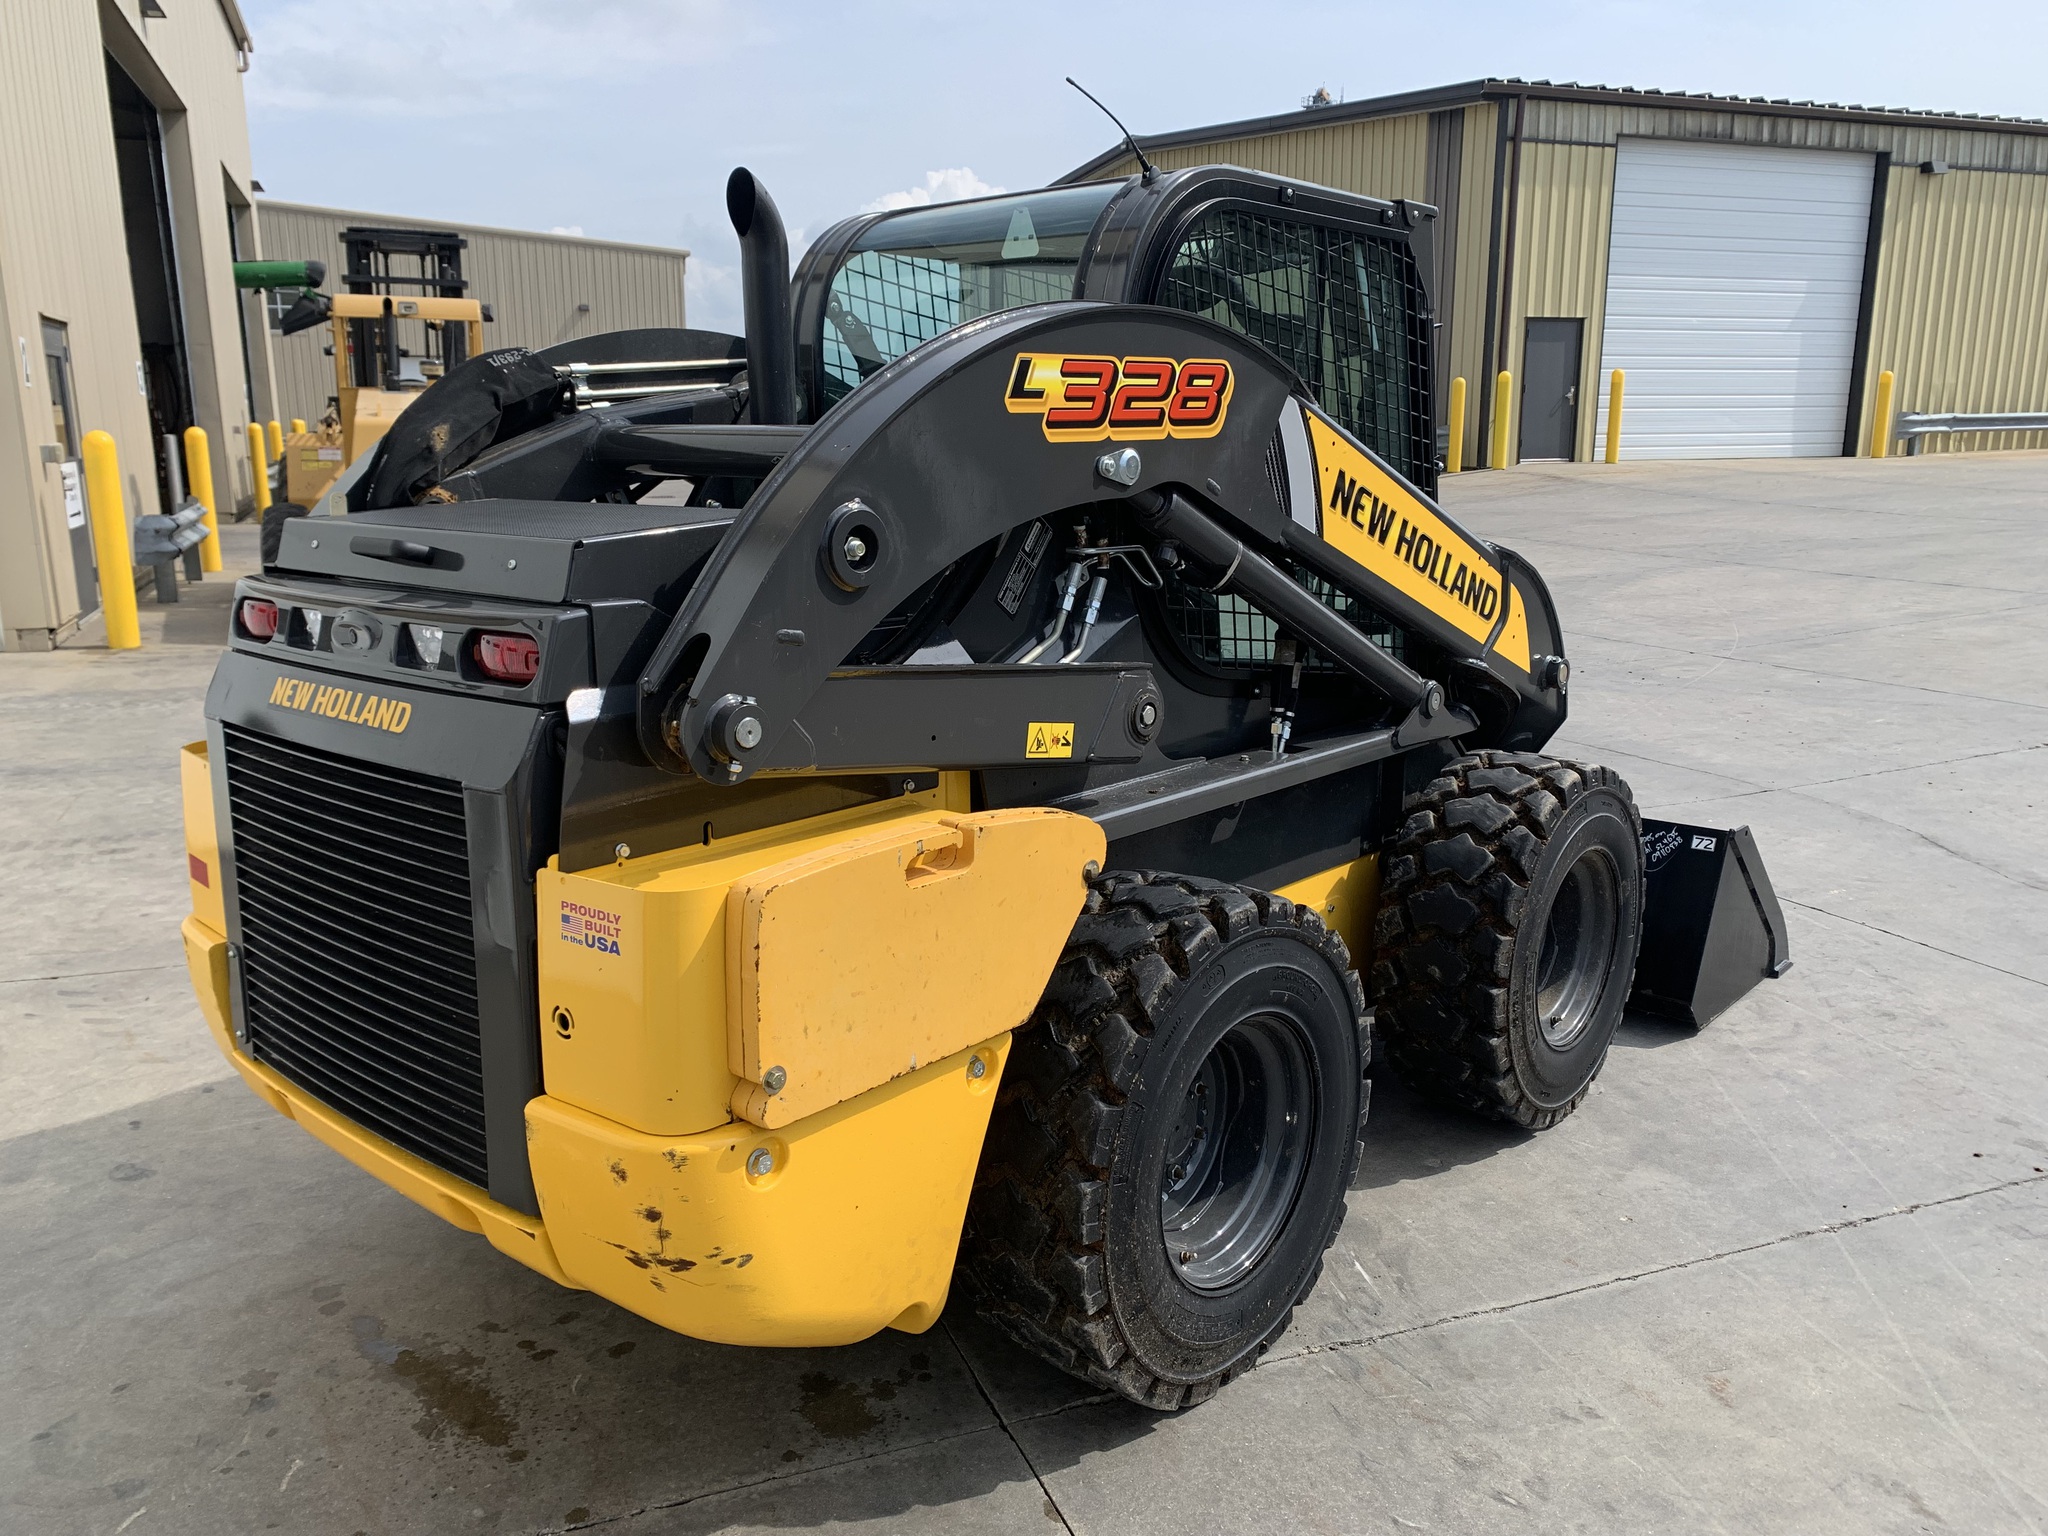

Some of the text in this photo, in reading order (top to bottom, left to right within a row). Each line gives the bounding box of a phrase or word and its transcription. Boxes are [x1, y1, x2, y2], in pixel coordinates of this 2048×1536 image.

[1007, 356, 1231, 430] L328
[1328, 468, 1499, 623] NEW HOLLAND
[268, 676, 412, 734] NEW HOLLAND
[1694, 836, 1714, 850] 72
[561, 900, 622, 926] PROUDLY
[584, 919, 622, 939] BUILT
[561, 932, 622, 956] in the USA
